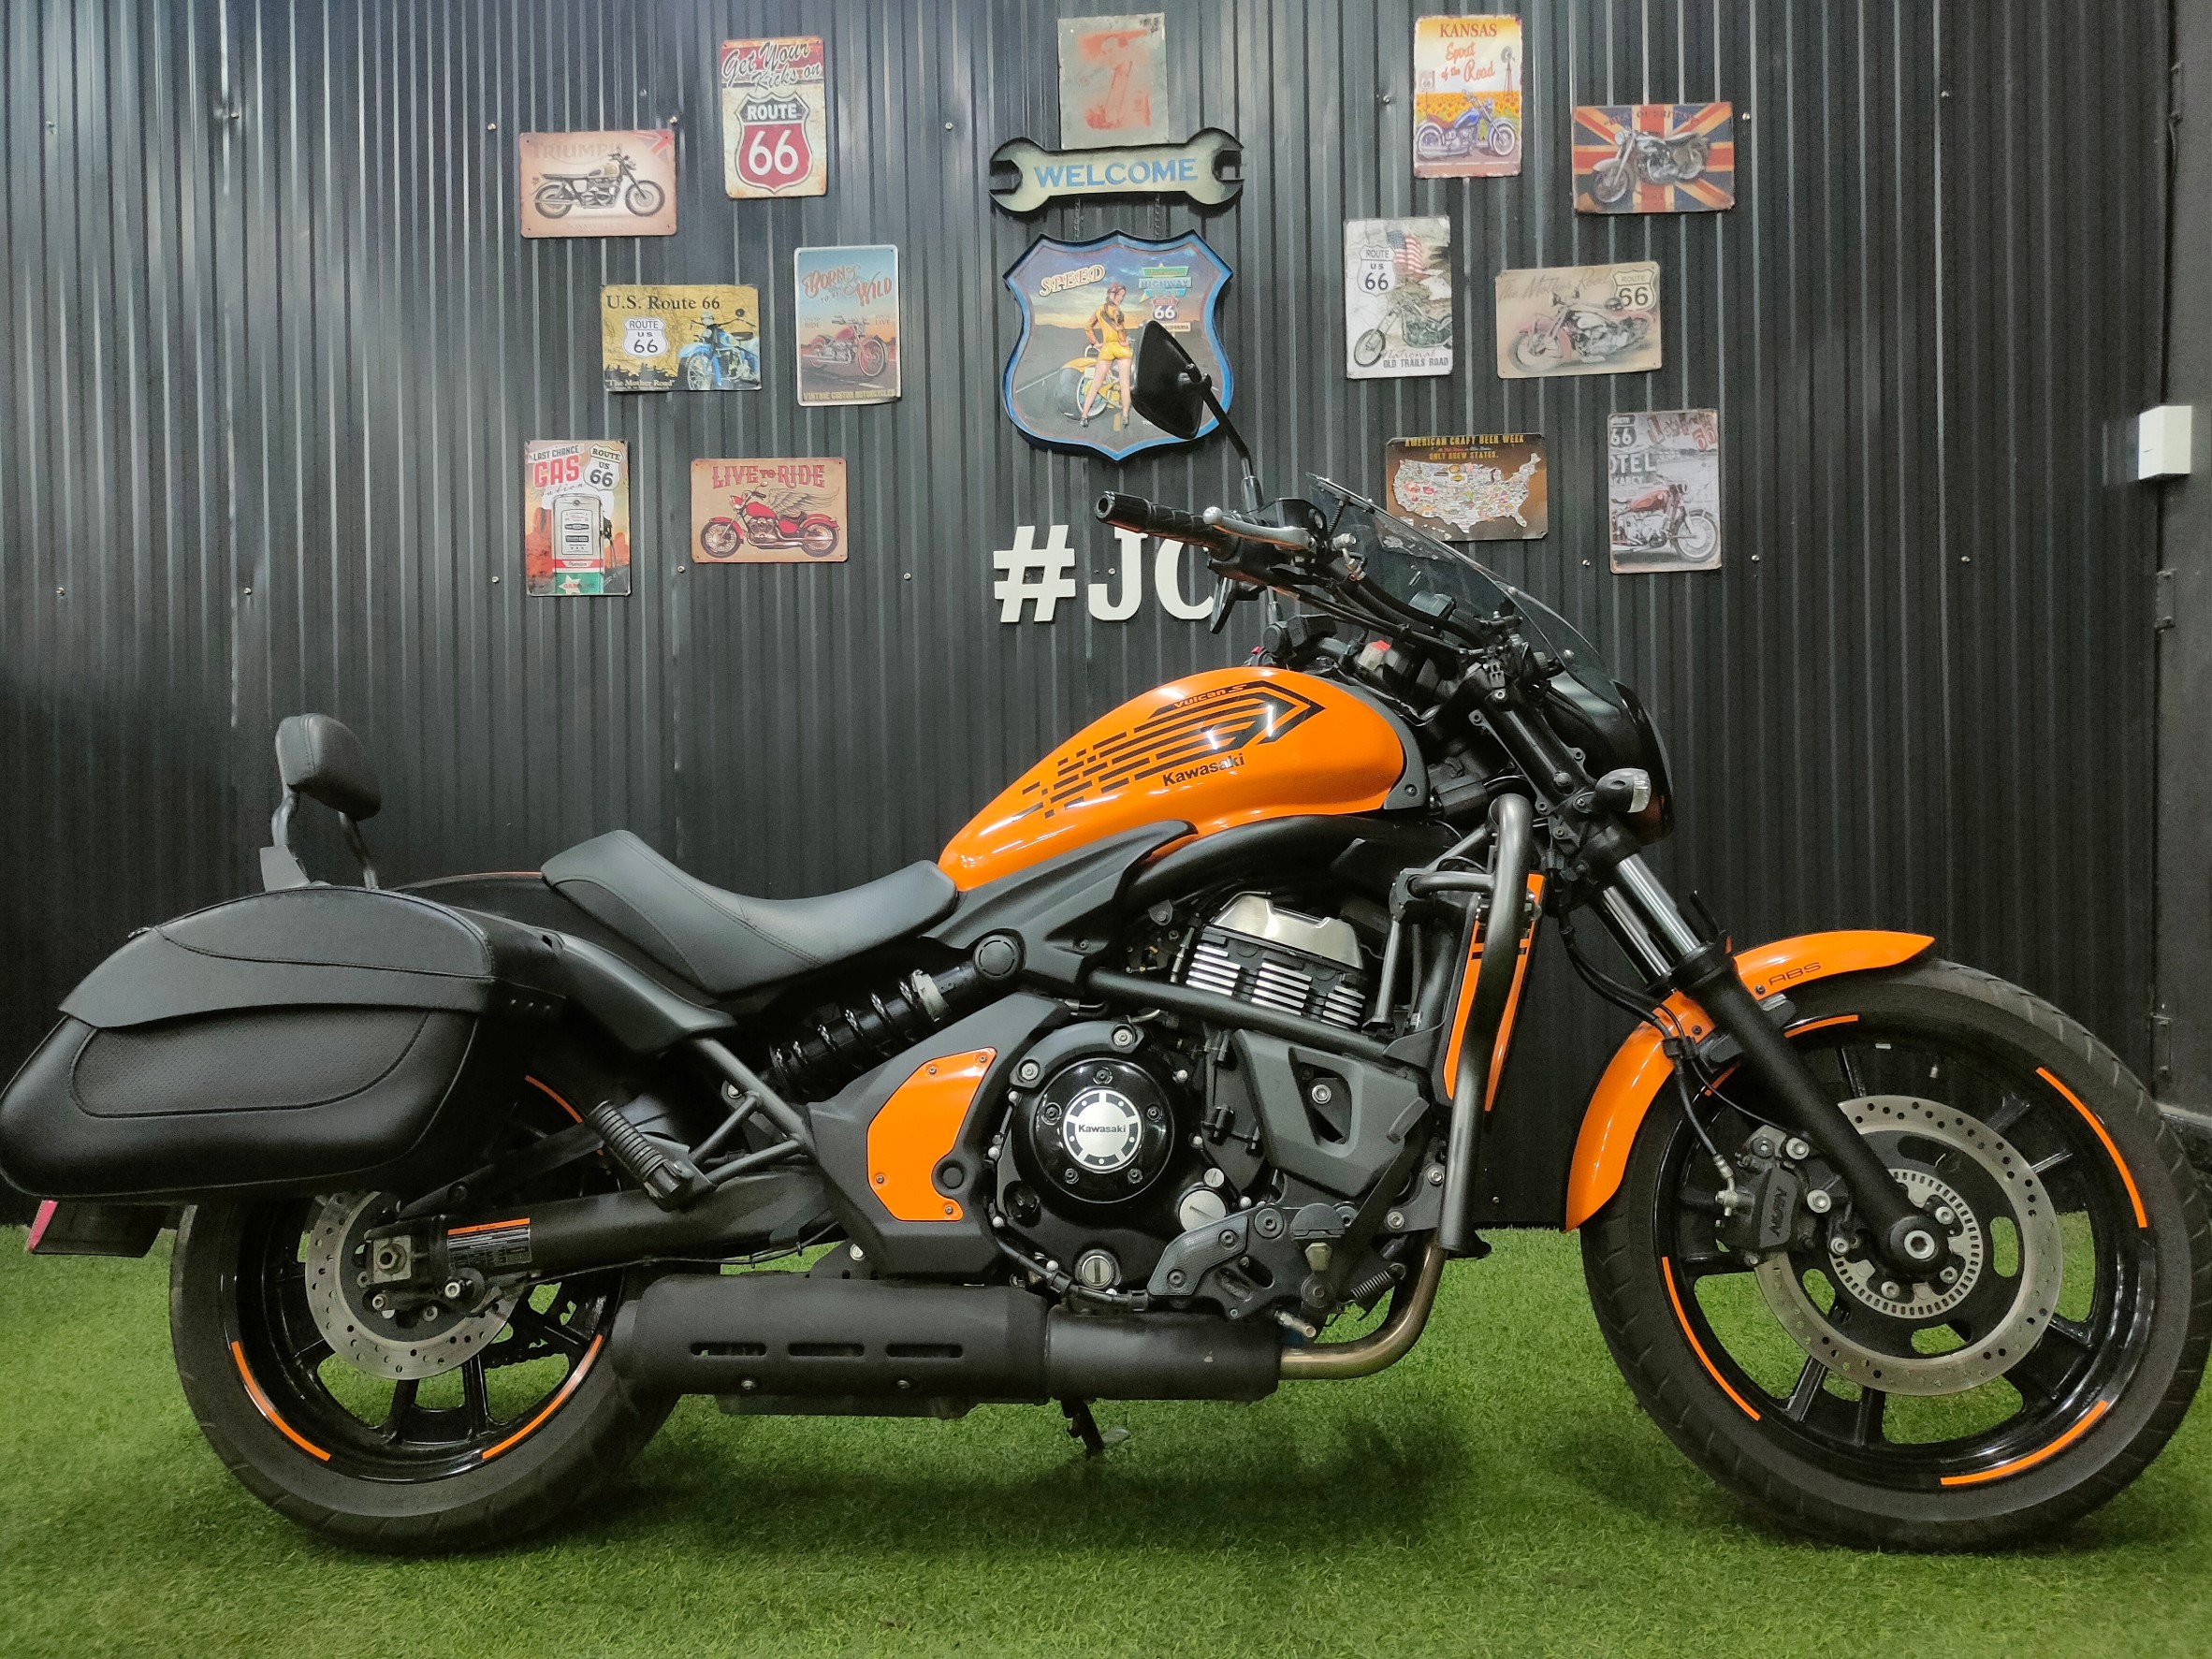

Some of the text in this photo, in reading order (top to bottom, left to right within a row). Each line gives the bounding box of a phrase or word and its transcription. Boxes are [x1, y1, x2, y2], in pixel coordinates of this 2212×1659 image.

[1439, 23, 1497, 37] KANSAS
[723, 41, 810, 87] Get Your
[1463, 59, 1495, 82] Road
[752, 64, 822, 92] Kicks on
[748, 104, 797, 120] ROUTE
[749, 130, 799, 176] 66
[1034, 158, 1199, 188] WELCOME
[1365, 250, 1390, 259] ROUTE
[1039, 264, 1106, 297] SPEED
[1365, 272, 1389, 291] 66
[1622, 274, 1645, 283] ROUTE
[606, 295, 720, 310] U.S. Route 66
[1154, 305, 1175, 320] 66
[629, 320, 659, 329] ROUTE
[633, 339, 659, 354] 66
[1383, 357, 1448, 368] OLD TRAILS ROAD
[1404, 434, 1524, 447] AMERICAN CRAFT BEER WEEK
[1610, 428, 1632, 445] 66
[532, 445, 579, 461] LAST CHANCE
[592, 448, 621, 461] ROUTE
[534, 455, 580, 488] GAS
[599, 461, 610, 470] US
[589, 470, 614, 488] 66
[712, 465, 825, 489] LIVE TO RIDE
[1162, 752, 1245, 787] Kawasaki
[1768, 962, 1822, 986] ABS
[1078, 1124, 1127, 1134] Kawasaki
